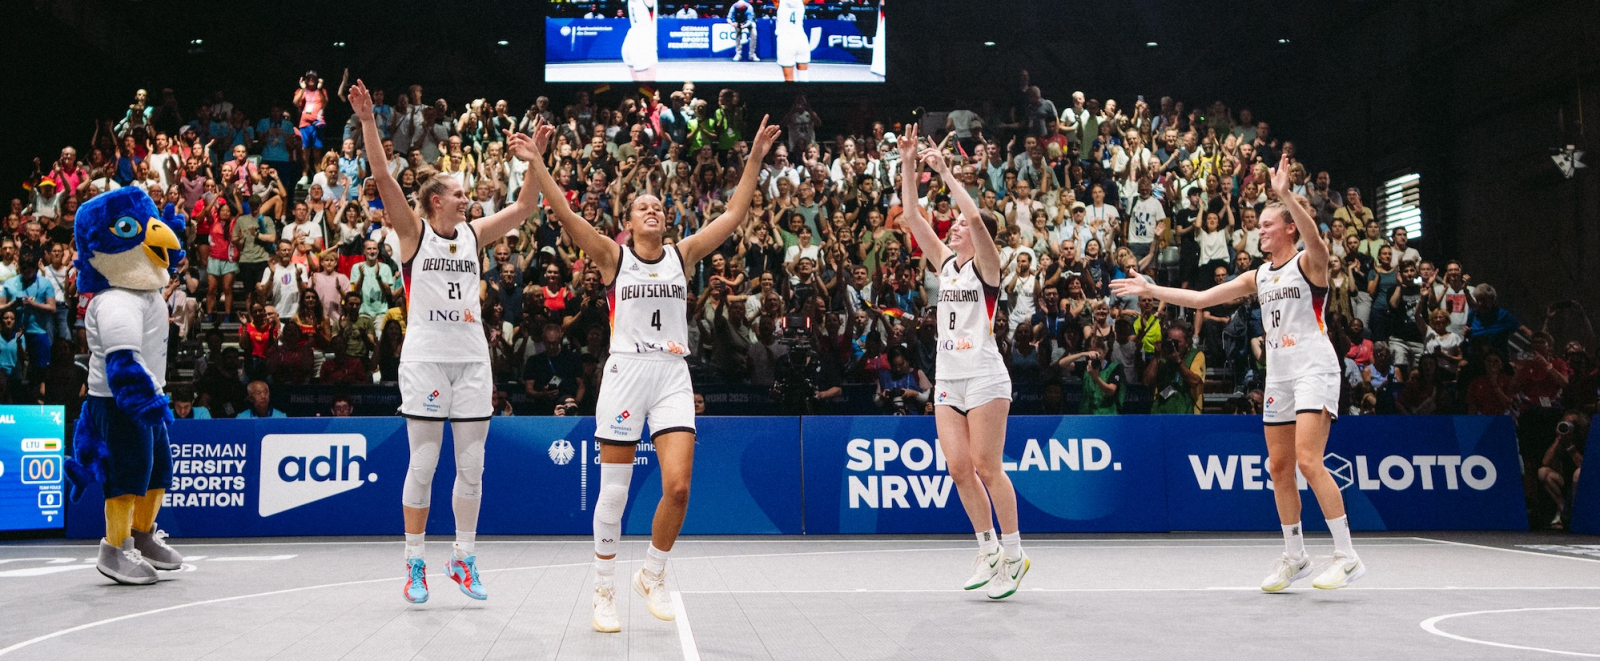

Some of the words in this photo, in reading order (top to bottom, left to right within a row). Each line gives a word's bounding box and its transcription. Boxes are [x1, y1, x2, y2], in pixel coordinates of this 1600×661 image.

[789, 11, 796, 24] 4
[828, 35, 876, 48] FISU
[447, 282, 462, 300] 21
[621, 284, 686, 301] DEUTSCHLAND
[429, 310, 460, 322] ING
[651, 309, 662, 331] 4
[949, 311, 956, 330] 8
[26, 441, 40, 449] LTU
[170, 444, 246, 458] GERMAN
[29, 459, 54, 480] 00
[278, 445, 378, 483] adh.
[1355, 455, 1497, 491] LOTTO
[170, 476, 245, 490] SPORTS
[46, 494, 54, 505] 0
[848, 475, 954, 509] NRW
[161, 493, 244, 507] ERATION
